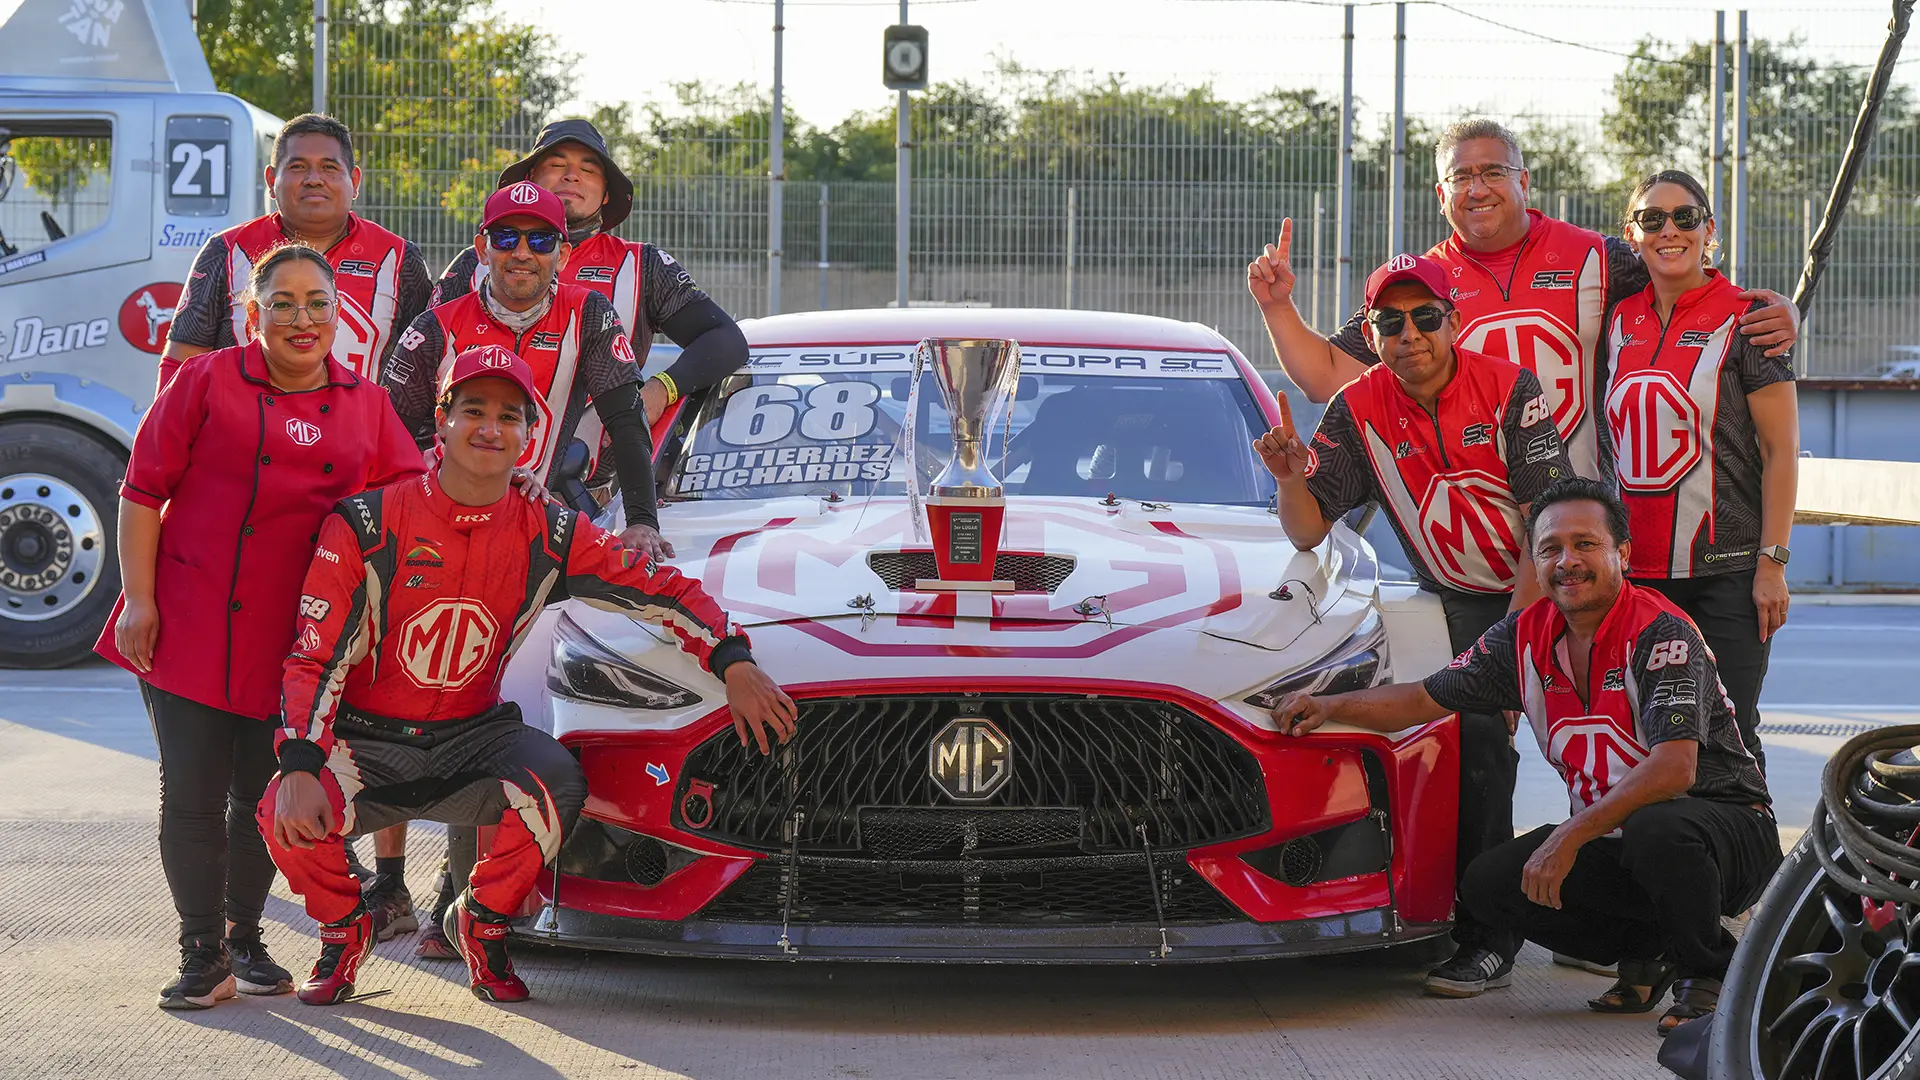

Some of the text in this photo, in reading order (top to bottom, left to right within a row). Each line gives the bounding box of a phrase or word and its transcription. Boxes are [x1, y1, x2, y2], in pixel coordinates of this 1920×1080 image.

[171, 143, 226, 195] 21
[511, 185, 538, 203] MG
[158, 223, 216, 247] Santi
[338, 260, 376, 273] SC
[577, 267, 615, 279] SC
[1388, 254, 1416, 272] MG
[1532, 270, 1575, 285] SC
[6, 316, 110, 362] Dane
[1679, 331, 1715, 343] SC
[482, 347, 510, 368] MG
[1159, 358, 1223, 370] SC
[717, 380, 882, 447] 68
[1520, 393, 1550, 429] 68
[288, 420, 318, 443] MG
[1528, 430, 1558, 456] SC
[1608, 382, 1690, 478] MG
[684, 443, 896, 475] GUTIERREZ
[677, 460, 891, 493] RICHARDS
[352, 497, 378, 536] HRX
[455, 512, 493, 522] HRX
[552, 507, 570, 544] HRX
[315, 545, 340, 565] riven
[300, 594, 331, 621] 68
[407, 608, 491, 682] MG
[1646, 639, 1689, 672] 68
[1651, 678, 1696, 700] SC
[936, 726, 1005, 794] MG
